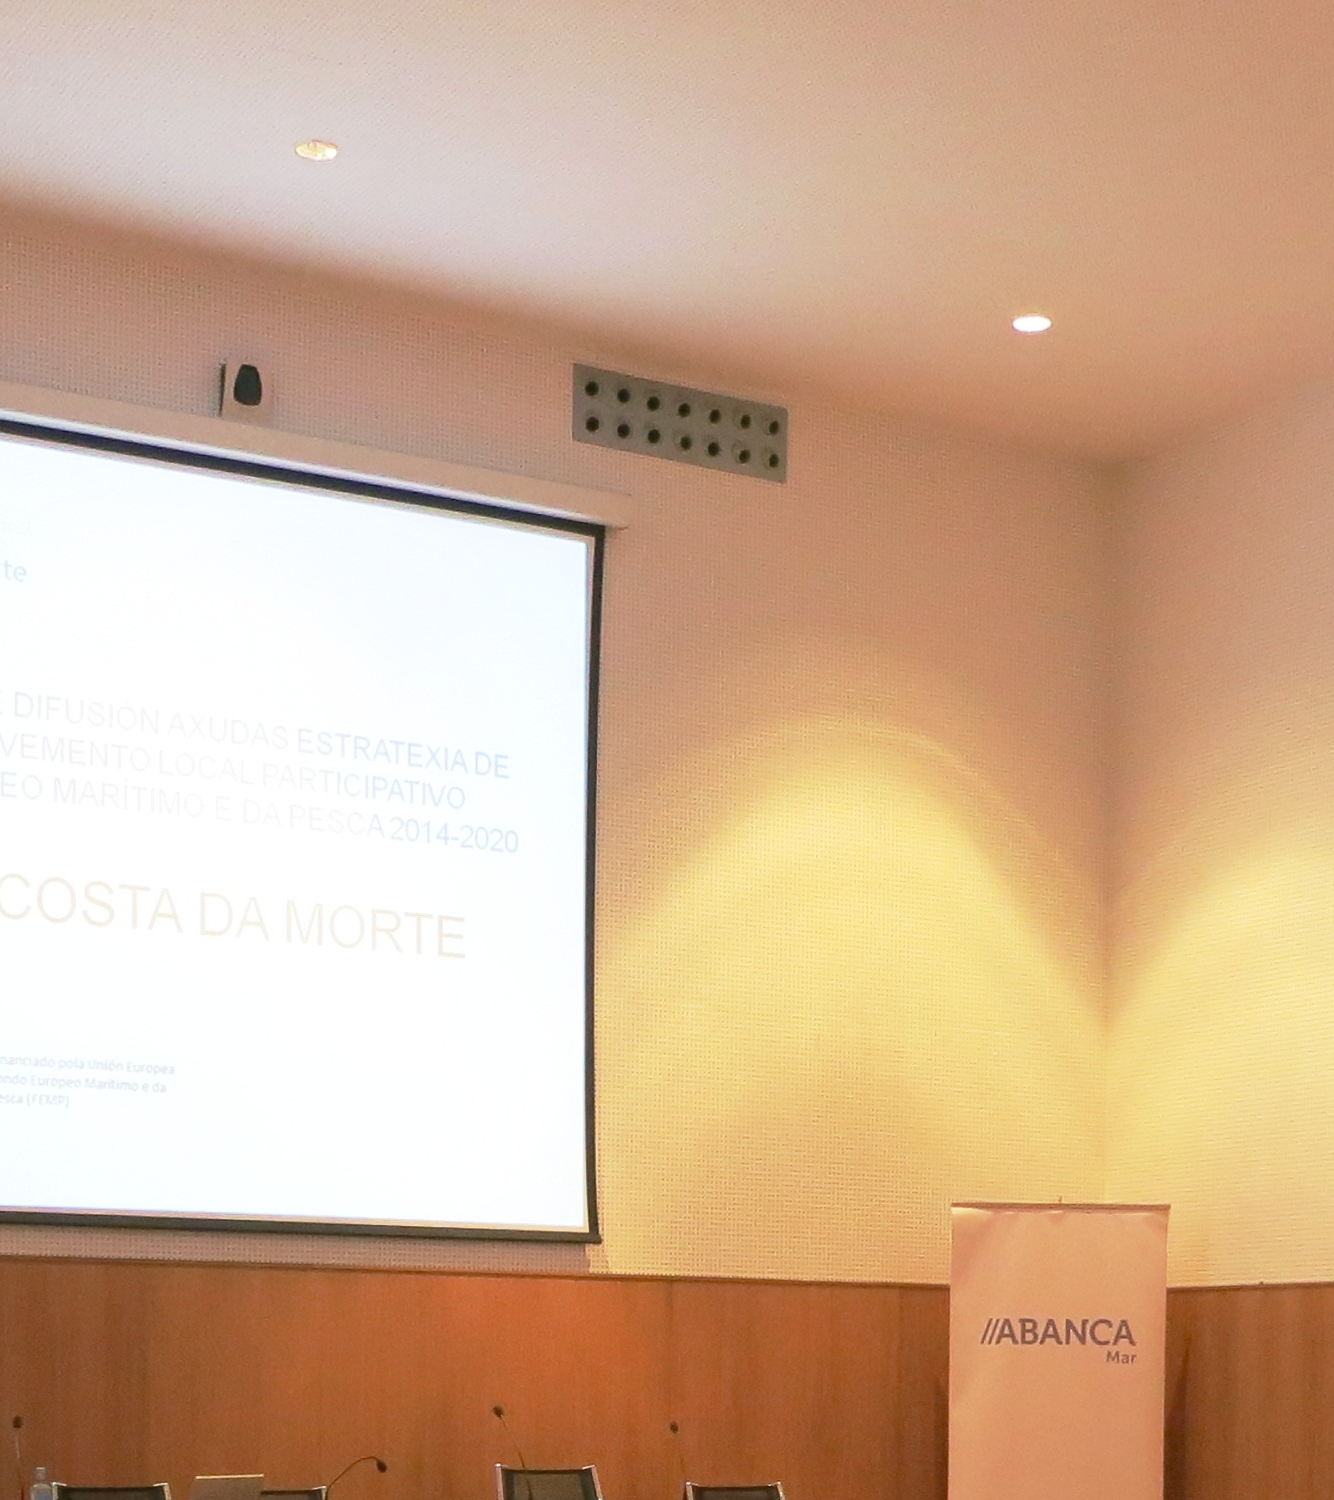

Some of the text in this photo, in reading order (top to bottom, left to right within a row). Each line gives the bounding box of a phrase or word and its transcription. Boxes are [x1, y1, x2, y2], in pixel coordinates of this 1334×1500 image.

[13, 691, 159, 734] DIFUSIÓN
[167, 711, 288, 750] AXUDAS
[297, 728, 468, 774] ESTRATEXIA
[474, 751, 510, 780] DE
[158, 749, 254, 786] LOCAL
[262, 763, 467, 810] PARTICIPATIVO
[52, 774, 204, 819] MARÍTIMO
[215, 795, 232, 822] E
[242, 798, 282, 827] DA
[289, 803, 385, 839] PESCA
[390, 815, 519, 854] 2014-2020
[199, 892, 270, 940] DA
[285, 899, 466, 960] MORTE
[1105, 1350, 1138, 1365] Mar
